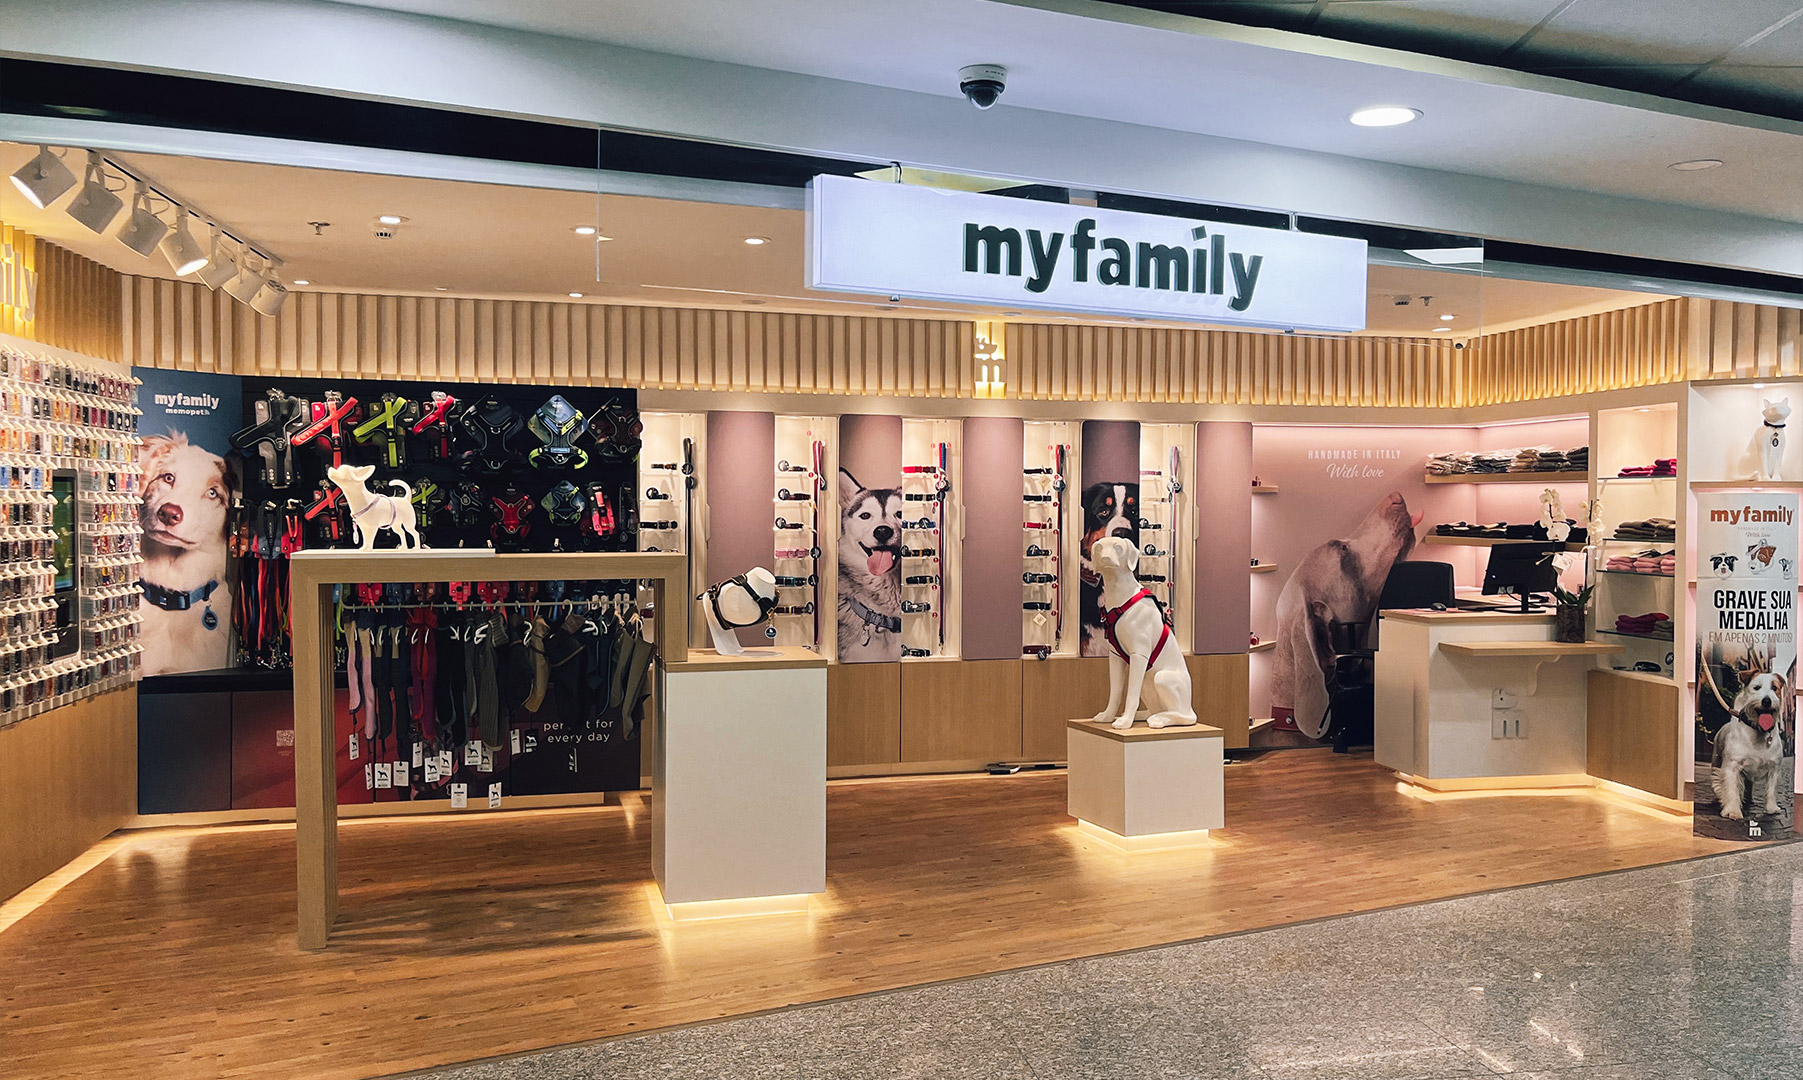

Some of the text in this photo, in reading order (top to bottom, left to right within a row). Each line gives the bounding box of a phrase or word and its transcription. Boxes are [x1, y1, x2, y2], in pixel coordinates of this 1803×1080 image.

[962, 218, 1264, 312] myfamily
[154, 392, 220, 410] myfamily
[1308, 449, 1401, 460] HANDMADE IN ITALY
[1326, 463, 1385, 479] With love
[1710, 505, 1793, 526] myfamily
[1714, 590, 1792, 610] GRAVE SUA
[1719, 610, 1789, 630] MEDALHA
[1709, 632, 1793, 644] EM APENAS 2 MINUTOS
[543, 718, 614, 732] pert for
[547, 731, 610, 744] every day
